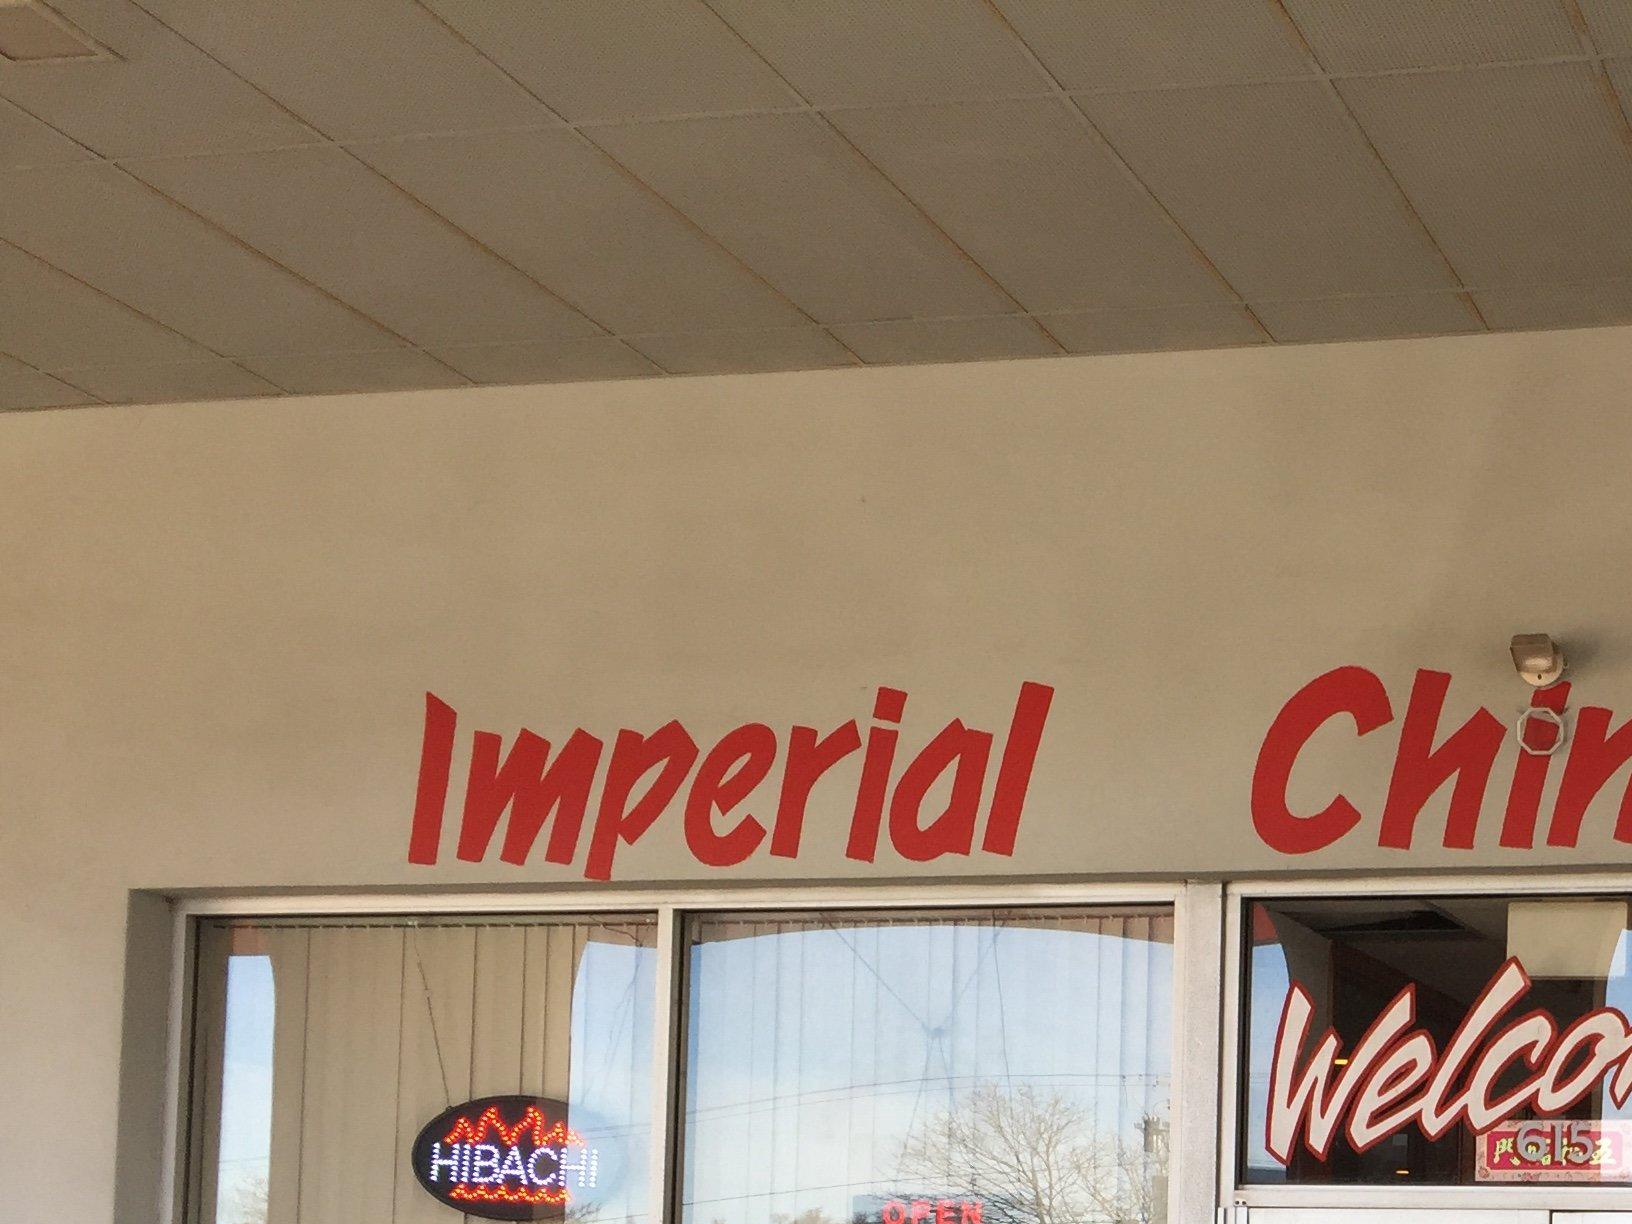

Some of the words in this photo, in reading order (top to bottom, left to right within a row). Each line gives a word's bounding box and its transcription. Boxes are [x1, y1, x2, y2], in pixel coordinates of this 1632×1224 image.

[408, 681, 1054, 880] Imperial
[429, 1141, 599, 1189] HIBACHI
[1517, 1121, 1594, 1164] 615
